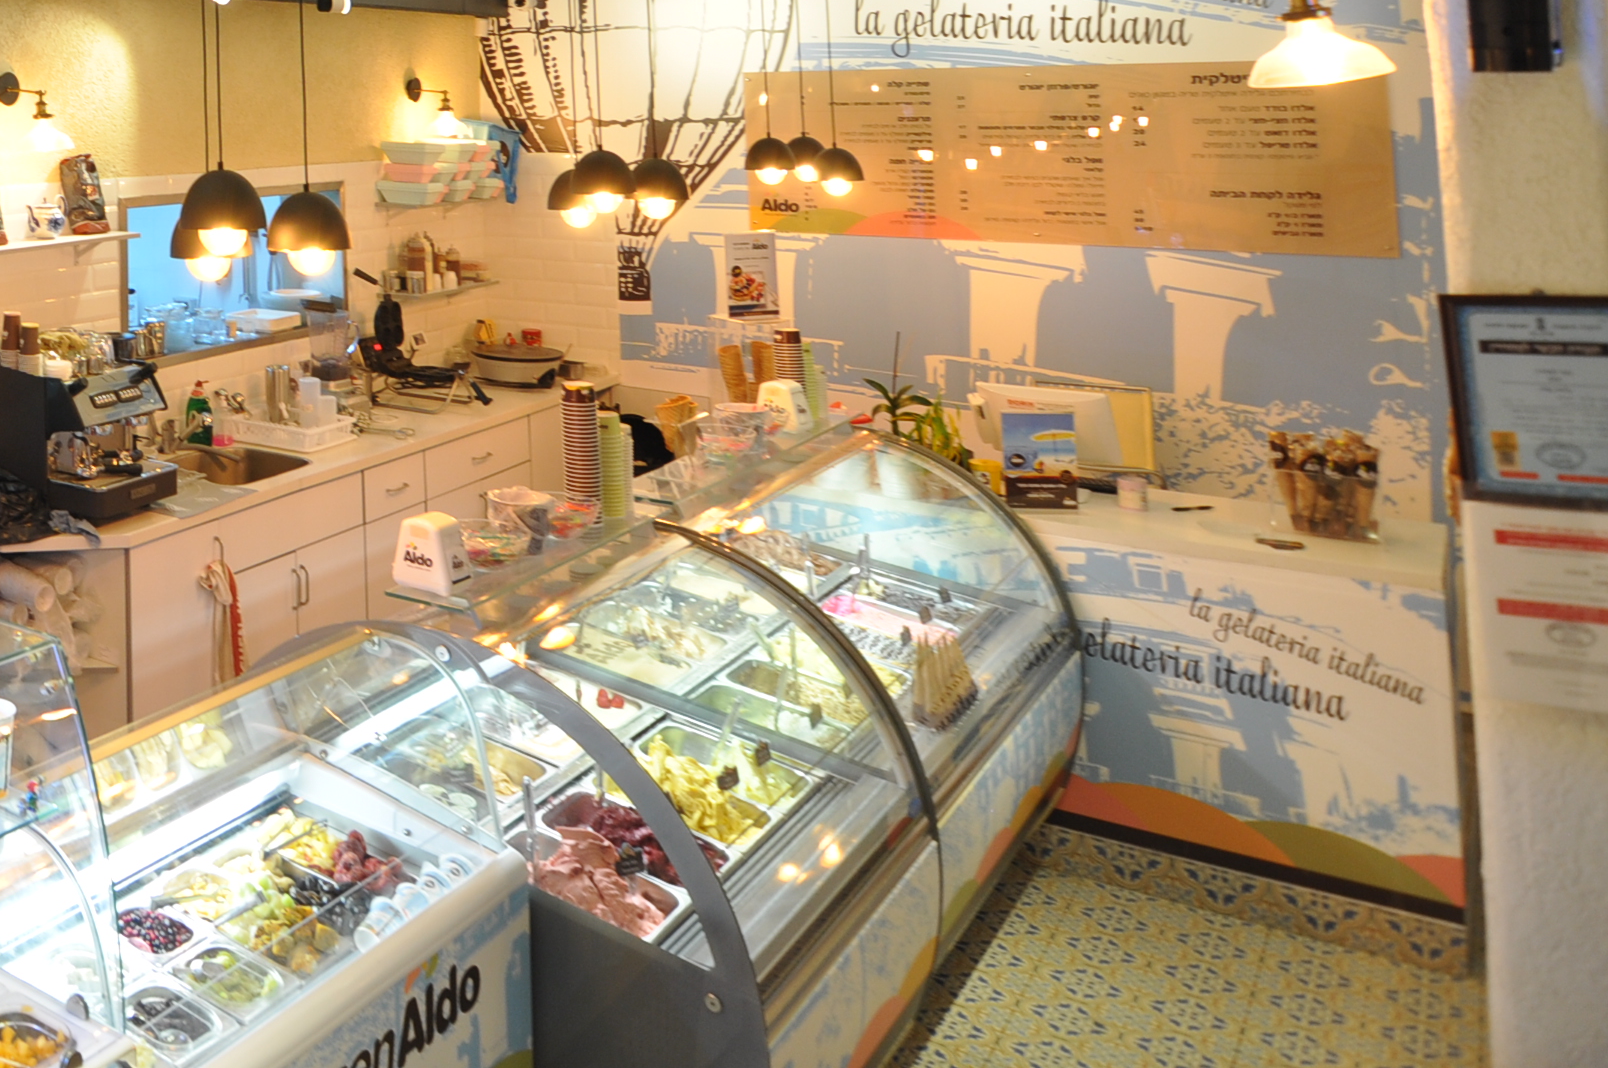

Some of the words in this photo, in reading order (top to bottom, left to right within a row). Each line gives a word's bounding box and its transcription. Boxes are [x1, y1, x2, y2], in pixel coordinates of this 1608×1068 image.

[1190, 72, 1249, 87] יטלקית
[760, 198, 801, 213] Aldo
[403, 549, 434, 568] Aldo
[1189, 587, 1211, 623] la
[1212, 609, 1321, 665] gelateria
[1327, 646, 1426, 706] italiana
[1084, 617, 1204, 685] elateria
[1213, 652, 1348, 722] italiana
